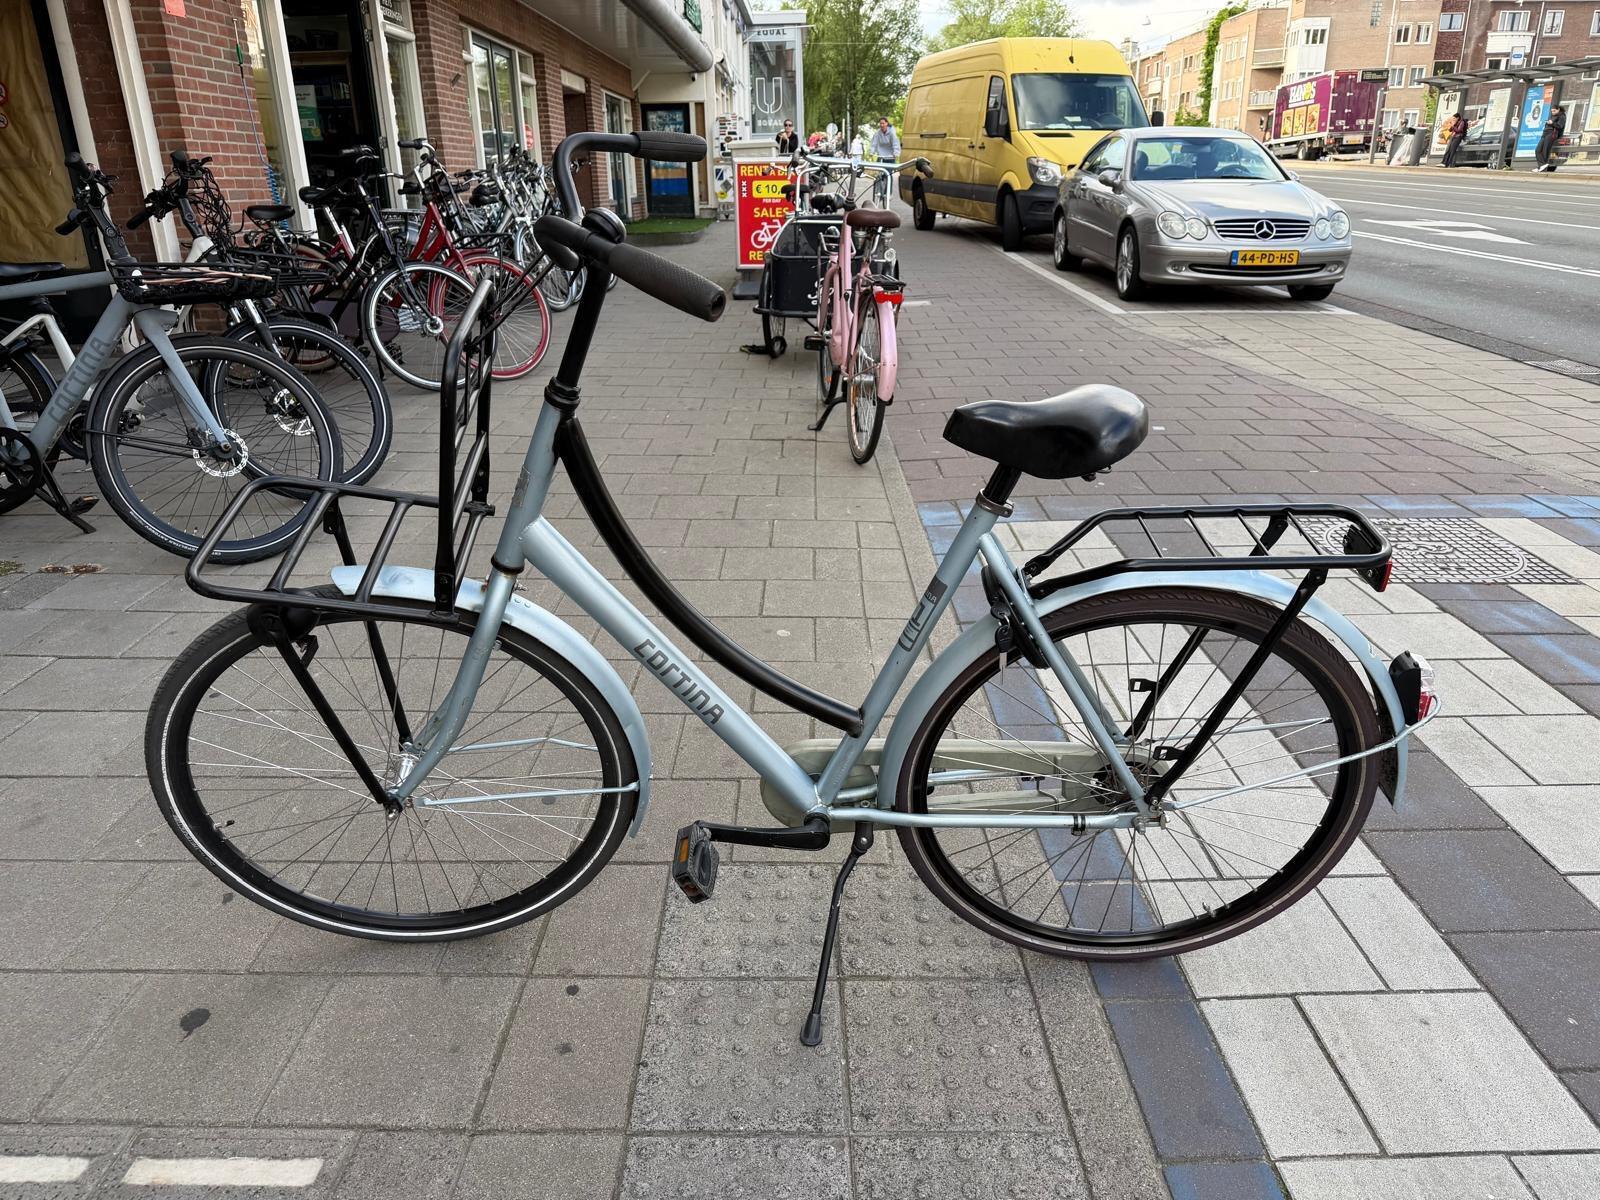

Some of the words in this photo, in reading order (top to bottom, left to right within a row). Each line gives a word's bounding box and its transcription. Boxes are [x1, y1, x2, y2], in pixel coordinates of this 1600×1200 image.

[757, 28, 787, 36] EQUAL
[753, 207, 790, 218] SALES
[1240, 252, 1295, 264] 44-PD-HS
[633, 638, 725, 725] CORTINA
